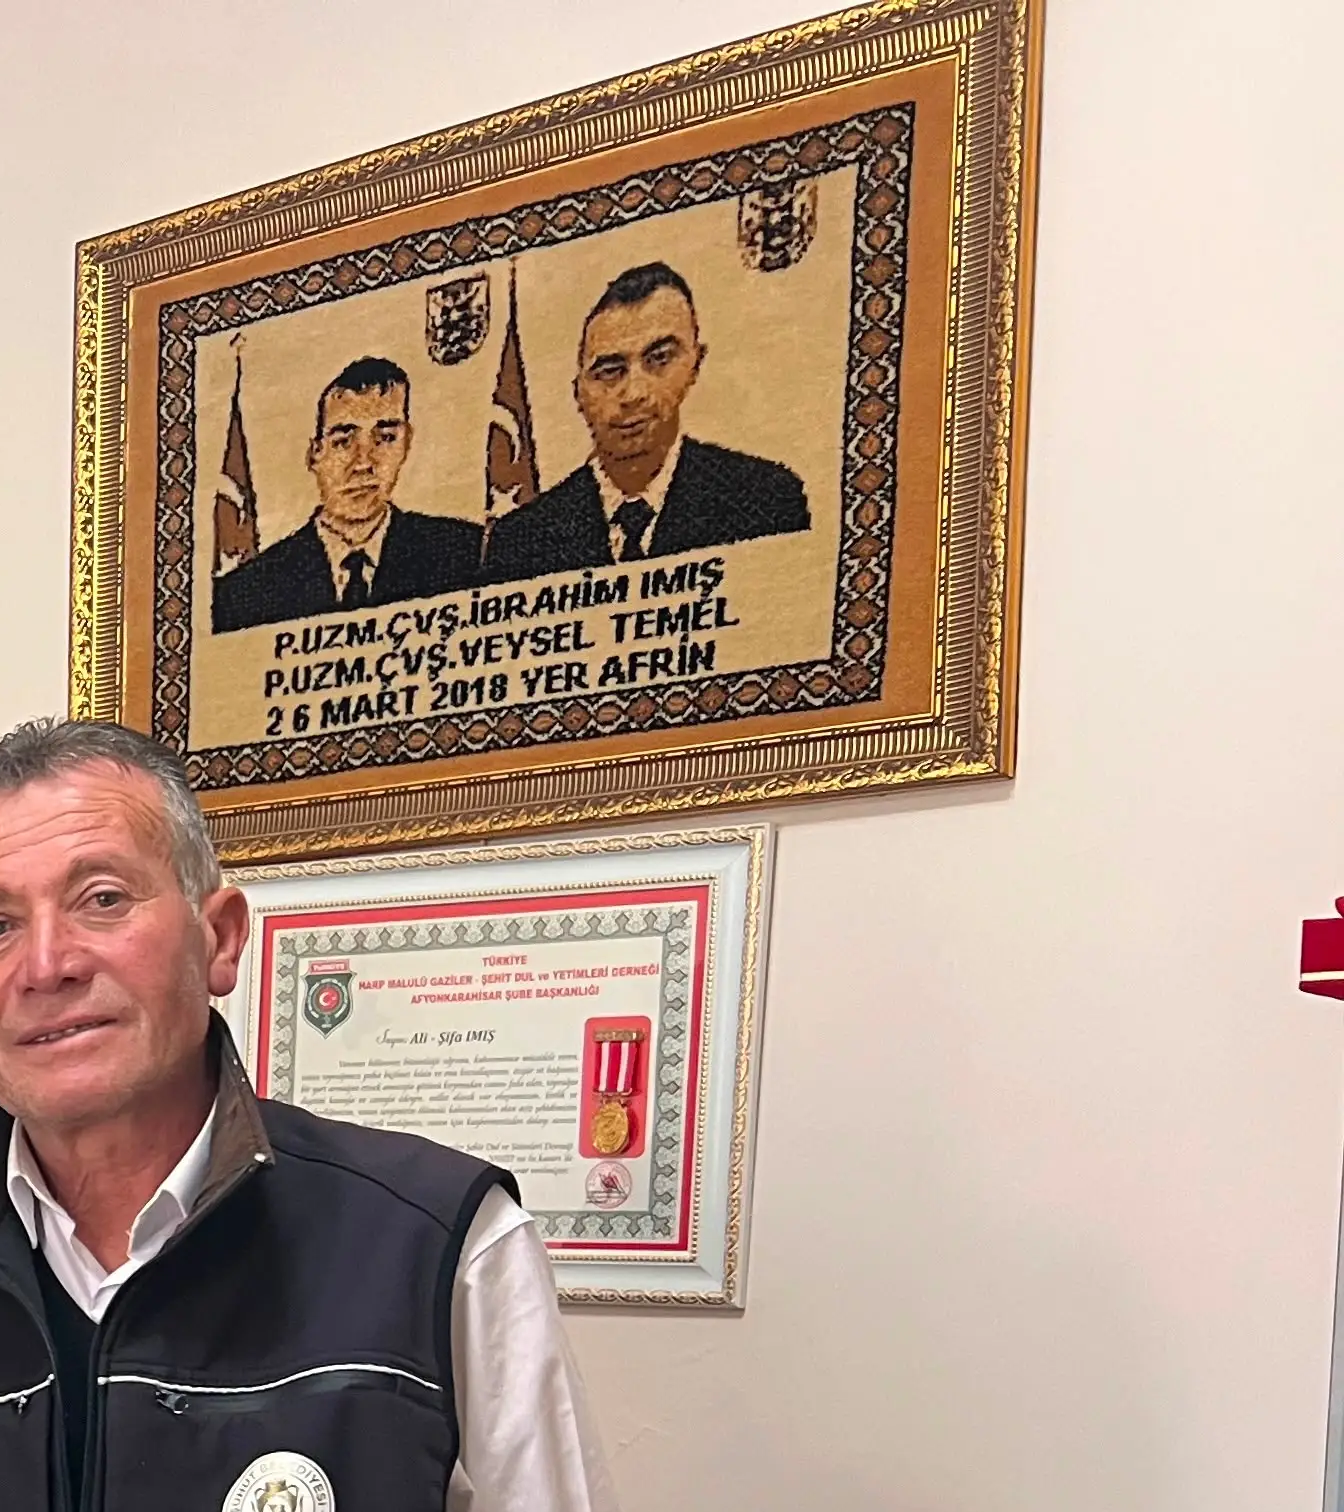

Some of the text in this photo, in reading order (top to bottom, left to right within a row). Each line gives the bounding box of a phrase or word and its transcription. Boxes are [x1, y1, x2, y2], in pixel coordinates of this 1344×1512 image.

[611, 597, 741, 644] TEMEL
[320, 684, 420, 727] MART
[430, 672, 509, 712] 2018
[520, 660, 590, 699] YER
[597, 635, 717, 687] AFRİN
[514, 972, 535, 983] DUL
